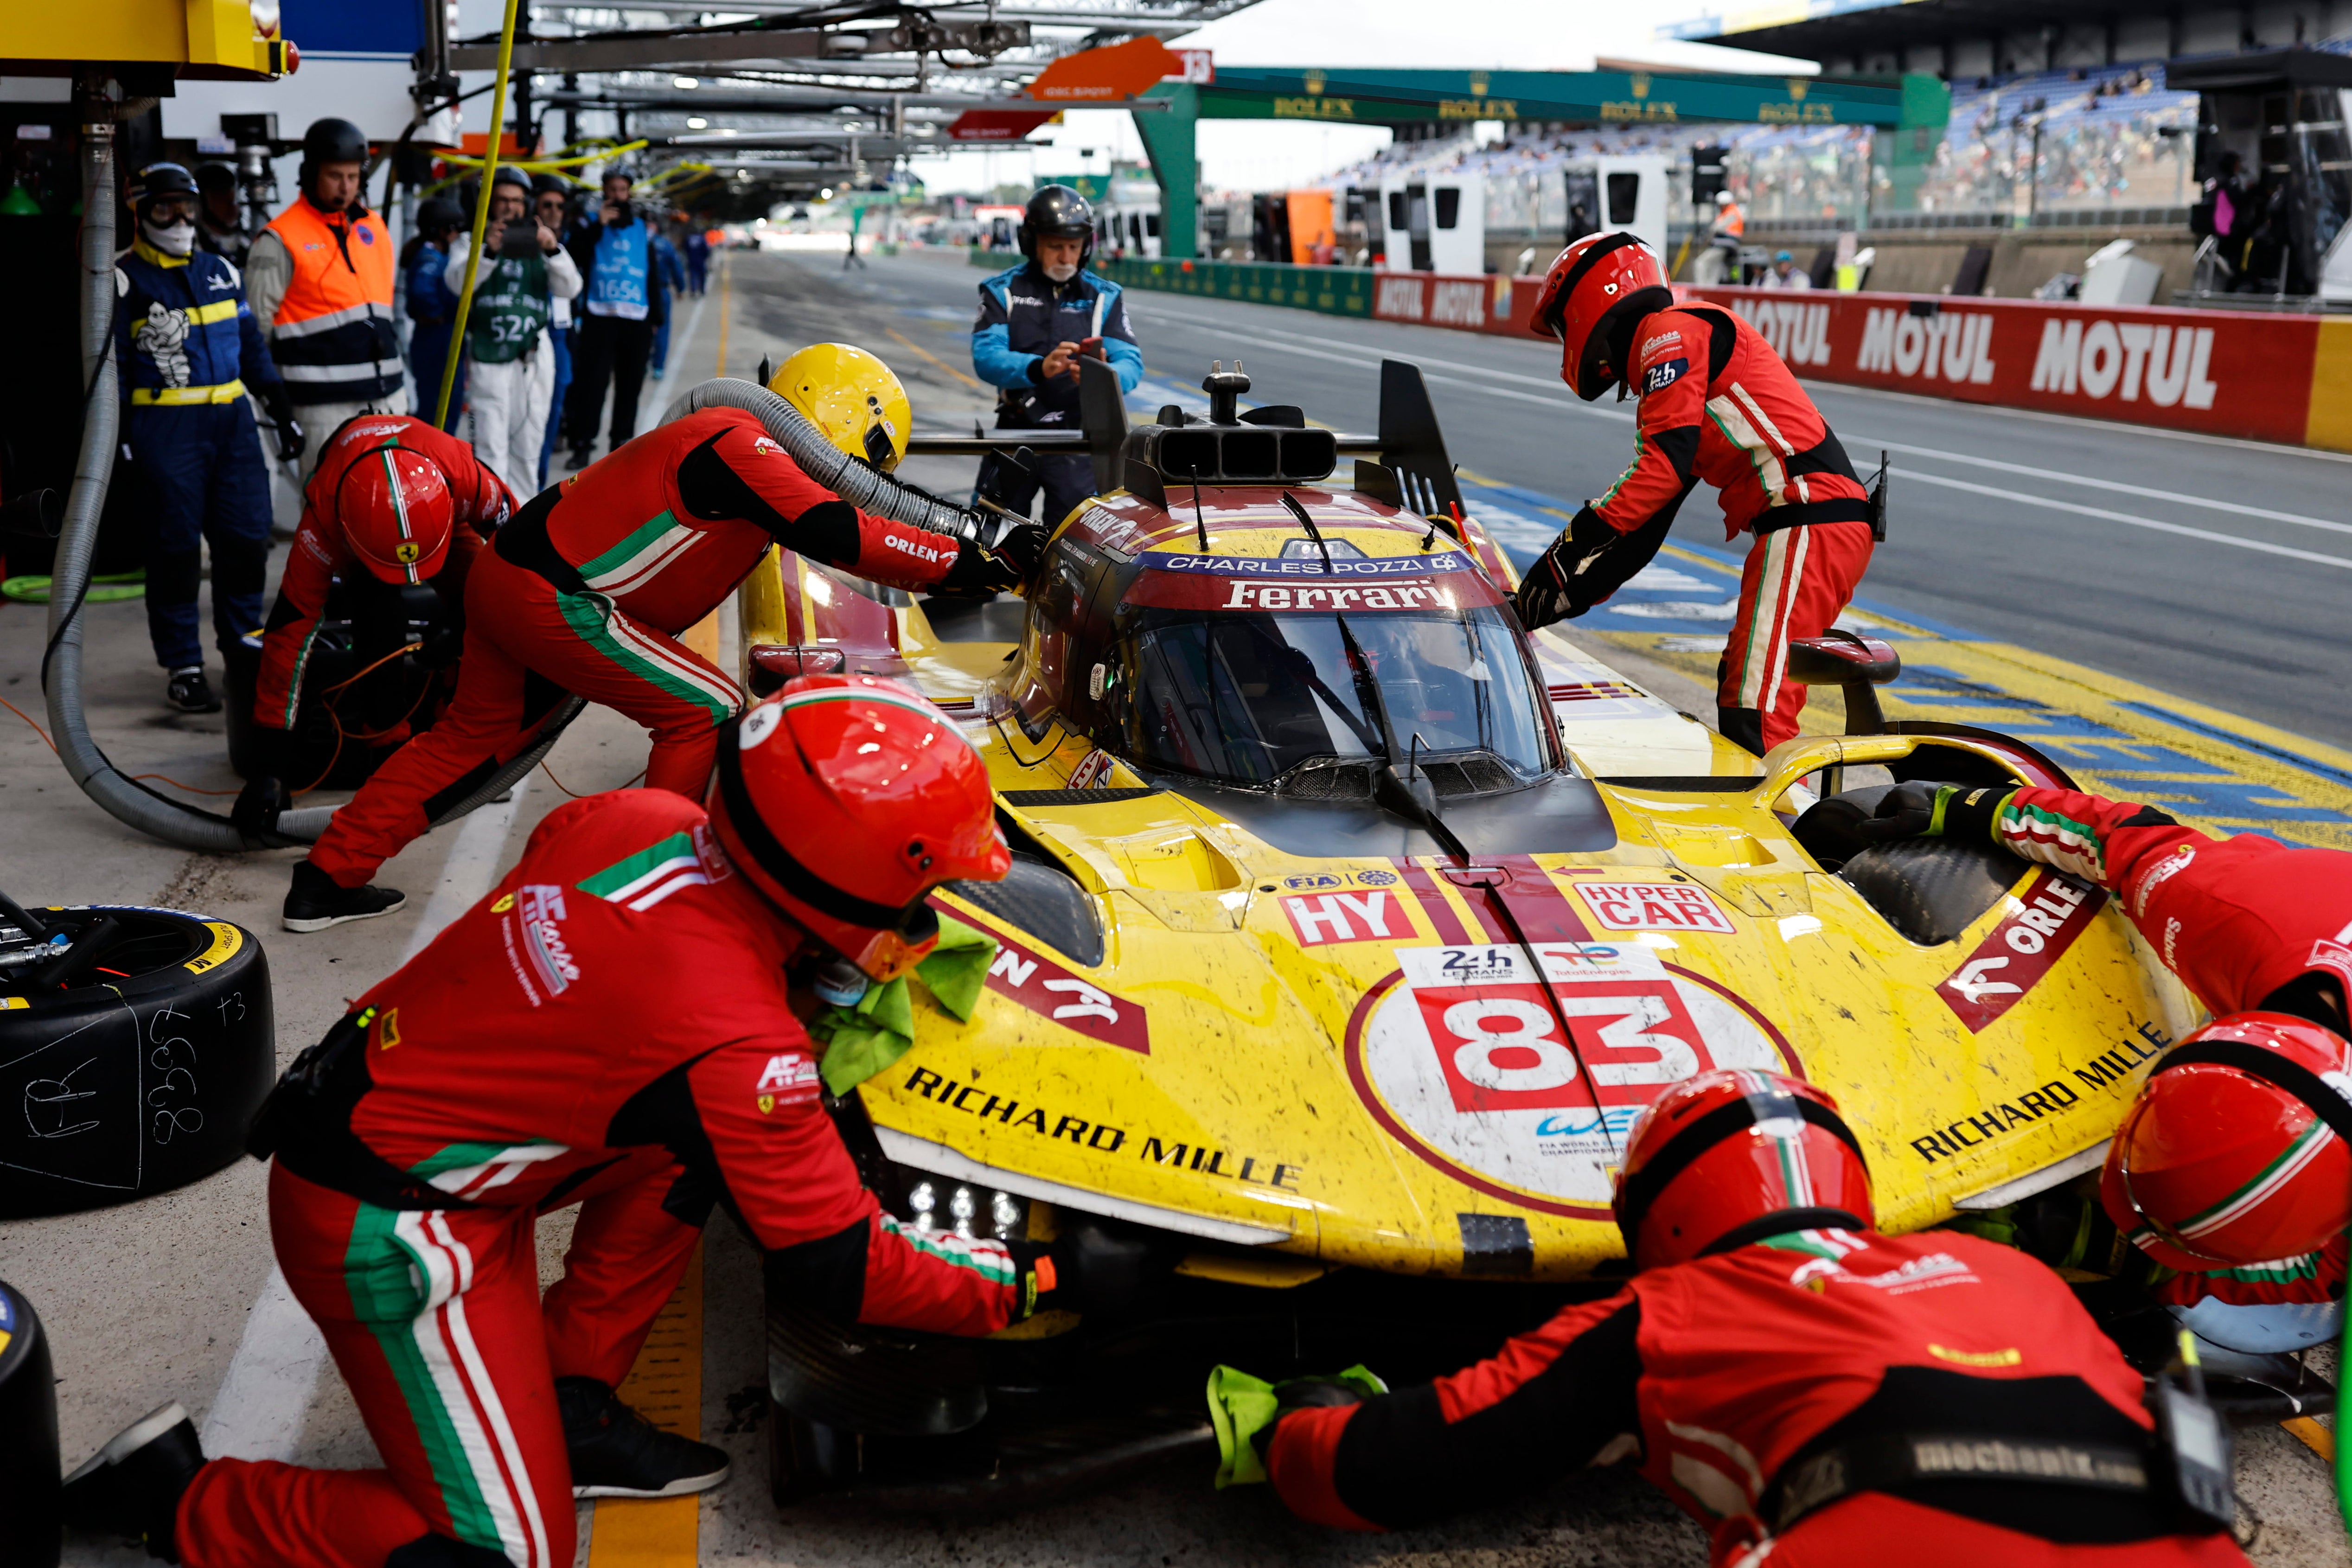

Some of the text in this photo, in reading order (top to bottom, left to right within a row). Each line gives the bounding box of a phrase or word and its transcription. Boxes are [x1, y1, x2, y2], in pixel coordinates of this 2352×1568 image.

[1182, 51, 1211, 82] 13
[1273, 97, 1354, 118] ROLEX
[1439, 100, 1518, 119] ROLEX
[1600, 101, 1677, 122] ROLEX
[1758, 102, 1834, 124] ROLEX
[1858, 308, 1995, 384] MOTUL
[2031, 318, 2218, 410] MOTUL
[821, 422, 833, 438] ENRICO
[885, 421, 895, 435] BELL
[1079, 506, 1120, 534] ORLEN
[884, 534, 938, 563] ORLEN
[1166, 557, 1324, 574] CHARLES
[1334, 559, 1424, 574] POZZI
[1222, 580, 1457, 611] Ferrari
[1288, 877, 1336, 888] FIA
[1584, 886, 1705, 902] HYPER
[1286, 891, 1392, 943] HY
[1599, 901, 1725, 928] CAR
[220, 936, 234, 949] SPORT
[191, 958, 213, 969] M
[1443, 995, 1700, 1092] 83
[1910, 1021, 2173, 1163] RICHARD MILLE
[904, 1066, 1304, 1193] RICHARD MILLE
[1537, 1110, 1644, 1136] WE
